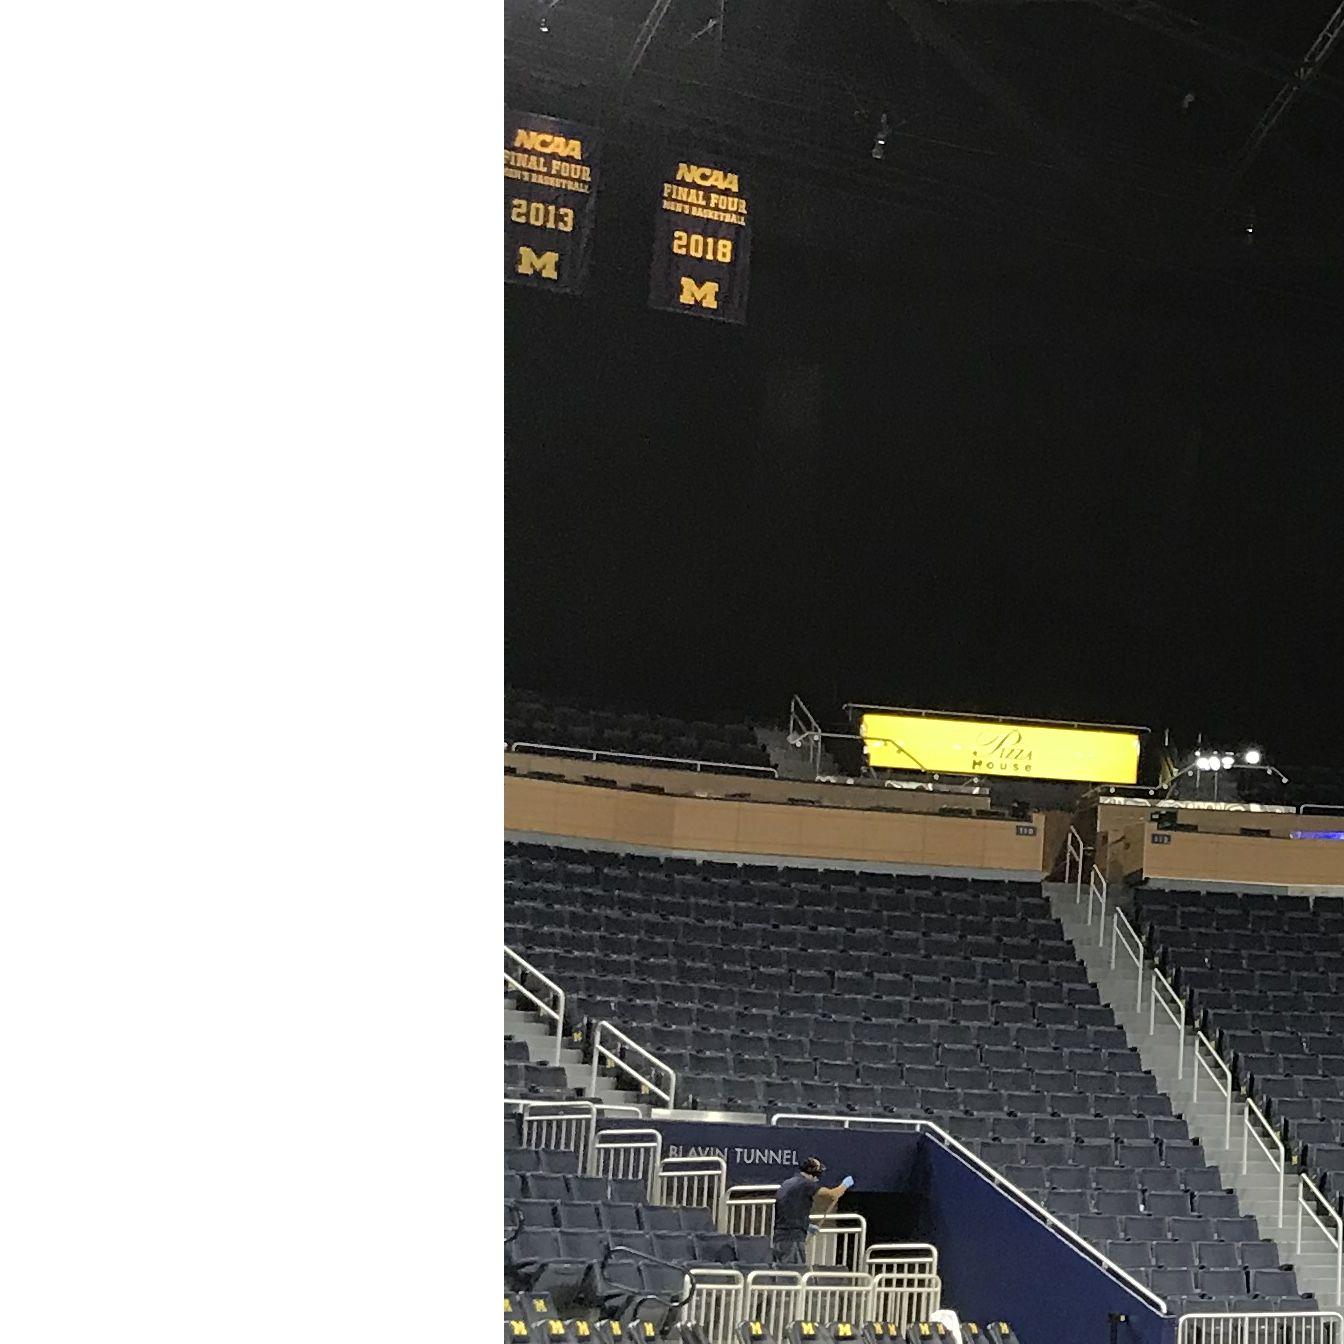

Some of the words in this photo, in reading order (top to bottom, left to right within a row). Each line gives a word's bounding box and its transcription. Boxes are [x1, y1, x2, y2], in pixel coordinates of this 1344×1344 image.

[514, 129, 582, 160] NCAA
[551, 159, 591, 181] FOUR
[675, 162, 739, 193] NCAA
[511, 198, 574, 232] 2013
[663, 182, 706, 206] FINAL
[709, 192, 748, 215] FOUR
[517, 246, 559, 280] M
[672, 230, 733, 263] 2018
[679, 276, 719, 309] M
[734, 1147, 800, 1166] TUNNEL
